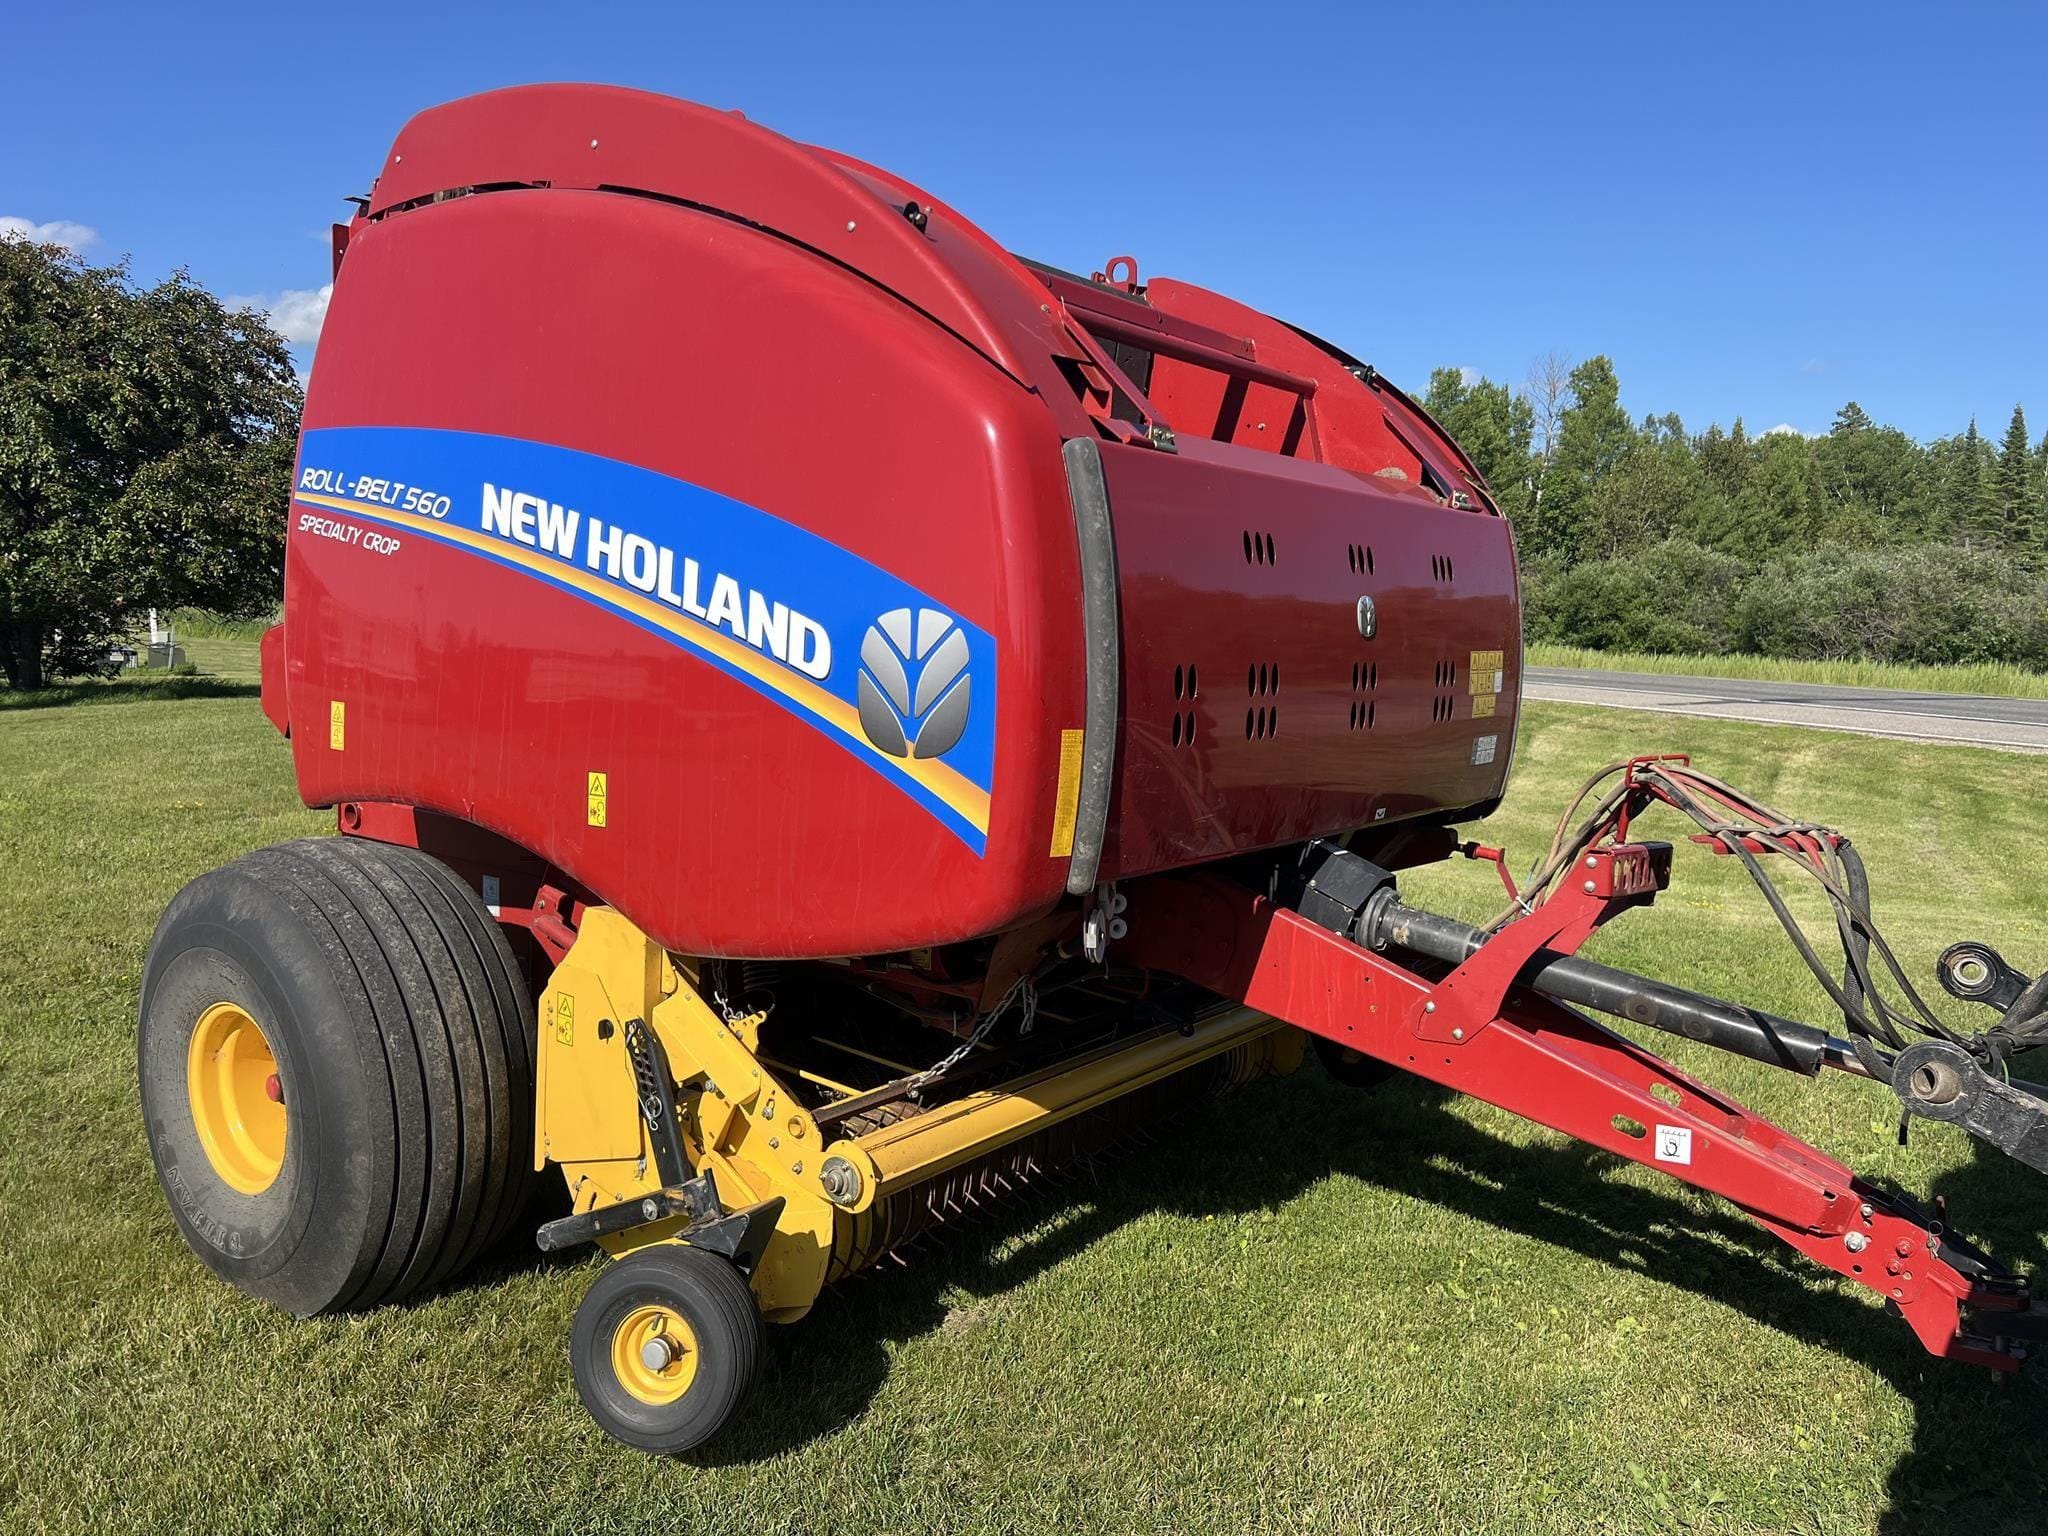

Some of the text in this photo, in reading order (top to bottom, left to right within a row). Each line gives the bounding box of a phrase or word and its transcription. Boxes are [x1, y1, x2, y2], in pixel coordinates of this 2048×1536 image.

[298, 513, 401, 556] SPECIALTY CROP
[402, 486, 451, 519] 560
[481, 482, 832, 681] NEW HOLLAND
[167, 1167, 227, 1252] TITAN
